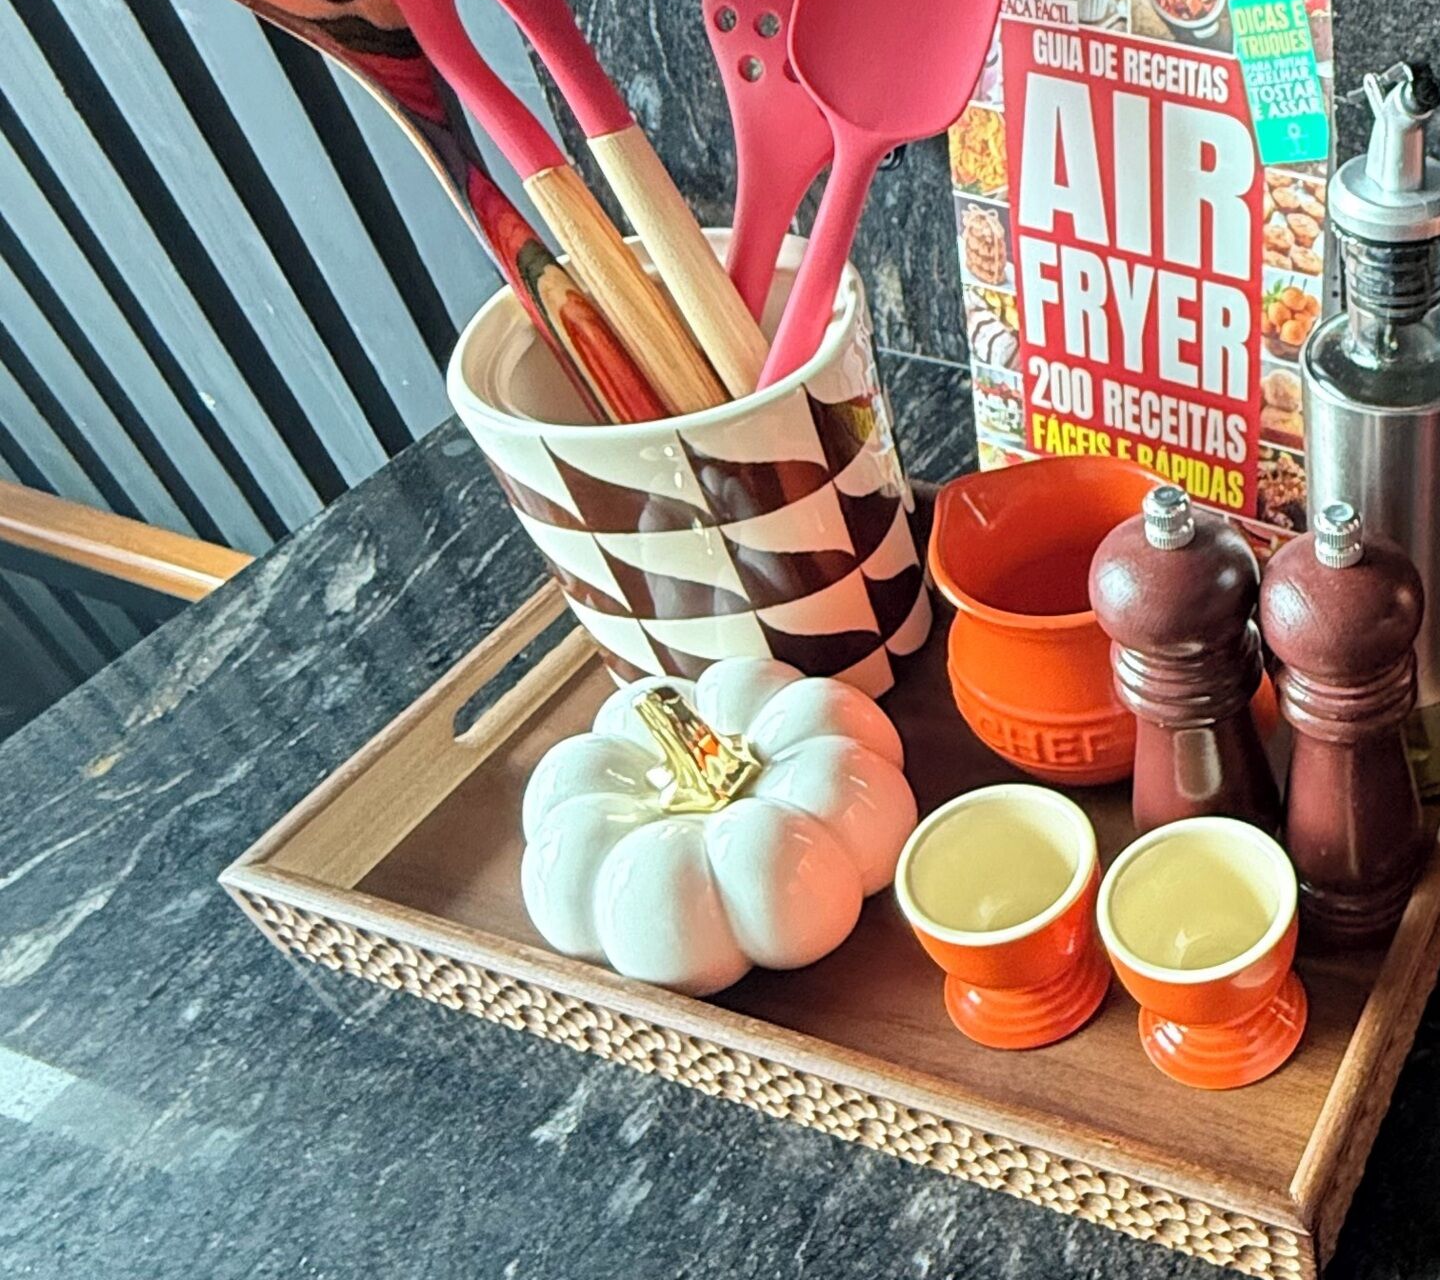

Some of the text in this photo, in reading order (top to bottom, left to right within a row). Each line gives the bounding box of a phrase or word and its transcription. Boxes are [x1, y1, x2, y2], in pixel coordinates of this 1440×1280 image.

[1234, 0, 1306, 35] DICAS E
[1033, 28, 1229, 104] GUIA DE RECEITAS
[1241, 30, 1310, 59] TRUQUES
[1247, 66, 1310, 86] GRELHAR
[1249, 79, 1317, 105] TOSTAR
[1251, 98, 1321, 121] E ASSAR
[1019, 71, 1256, 282] AIR
[1019, 234, 1251, 402] FRYER
[1028, 355, 1248, 464] 200 RECEITAS
[1031, 412, 1112, 458] FÁCEIS
[1137, 442, 1245, 509] RÁPIDAS
[978, 716, 1114, 764] CHEF
